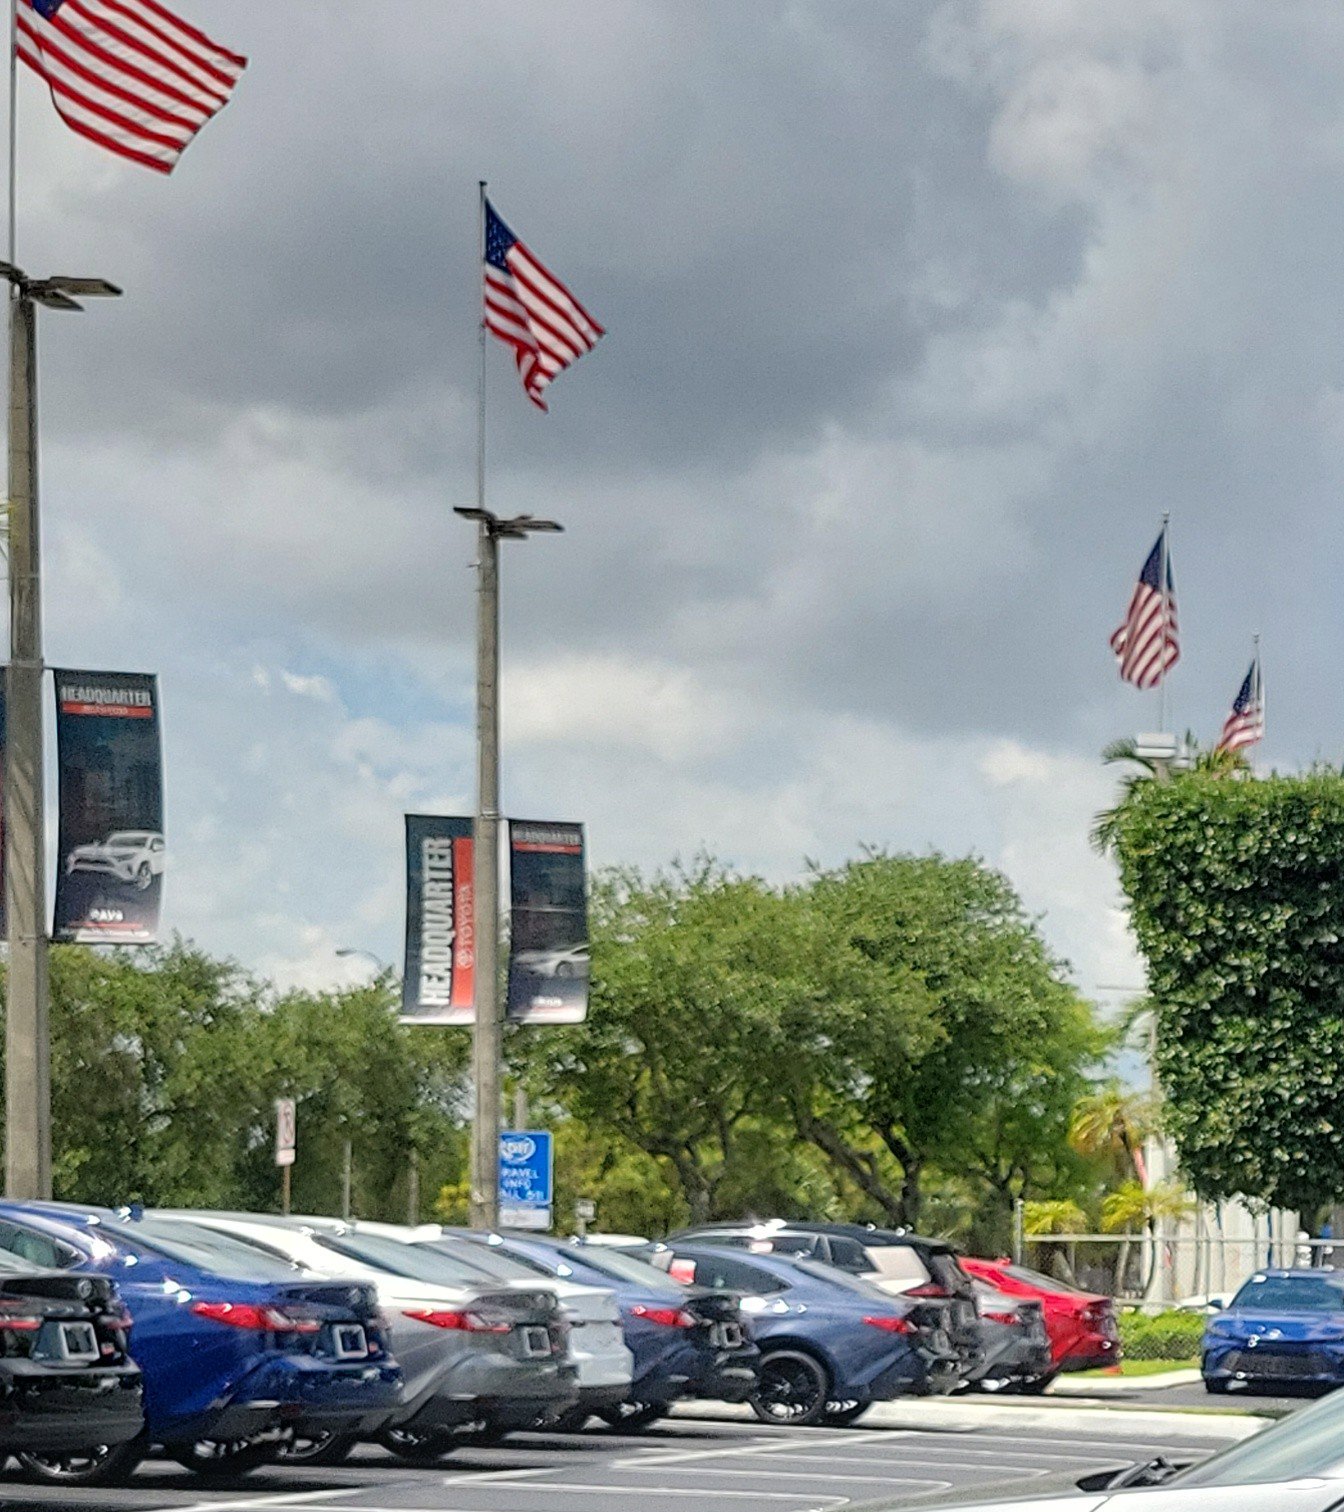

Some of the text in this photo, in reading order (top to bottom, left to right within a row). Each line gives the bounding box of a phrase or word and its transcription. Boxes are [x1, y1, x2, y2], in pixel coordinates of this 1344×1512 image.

[61, 686, 151, 706] HEADQUARTER
[418, 837, 456, 1006] HEADQUARTER
[456, 884, 474, 948] TOYOTA
